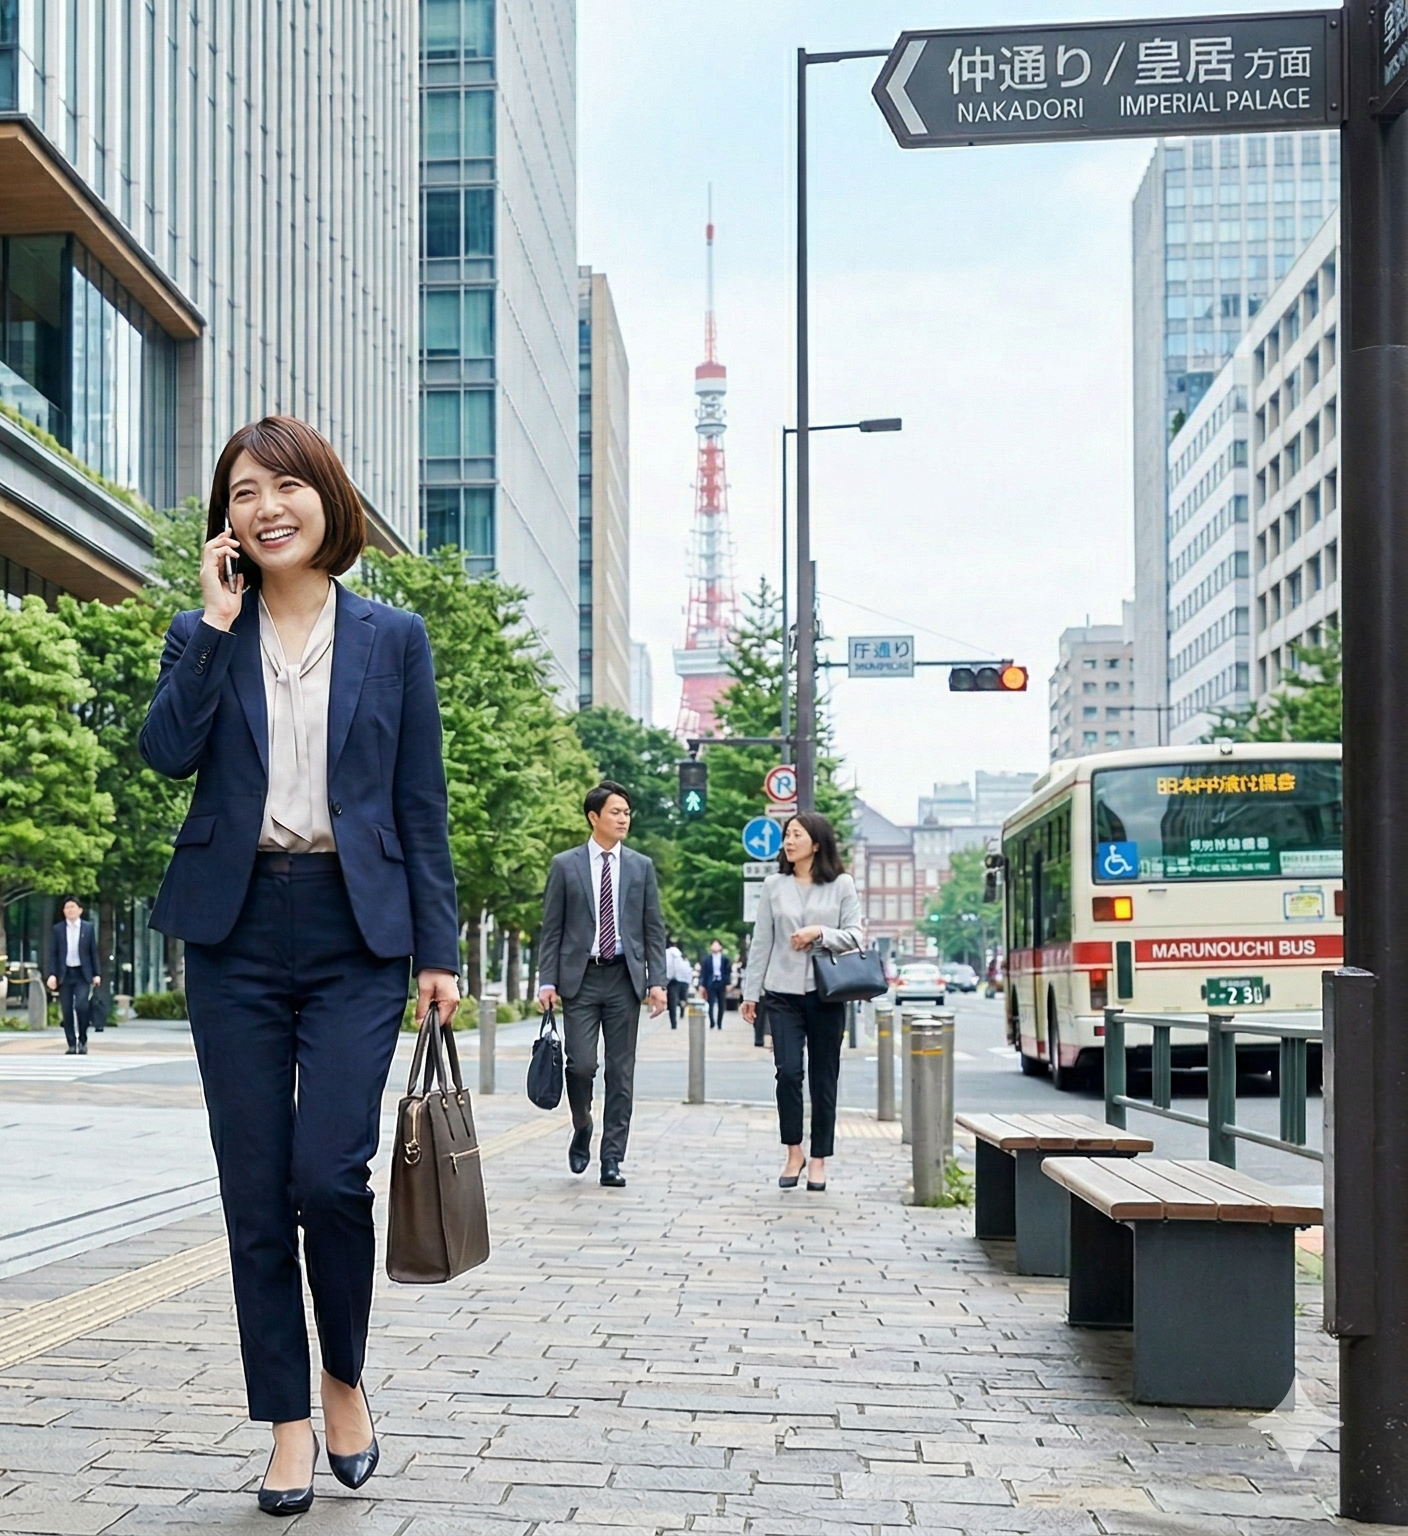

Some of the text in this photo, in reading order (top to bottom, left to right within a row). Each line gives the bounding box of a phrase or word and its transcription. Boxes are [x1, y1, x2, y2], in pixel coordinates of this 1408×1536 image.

[947, 45, 1091, 95] 仲通り
[1134, 36, 1235, 85] 皇居
[1244, 46, 1311, 80] 方面
[957, 88, 1310, 123] NAKADORI IMPERIAL PALACE
[1152, 940, 1316, 959] MARUNOUCHI BUS
